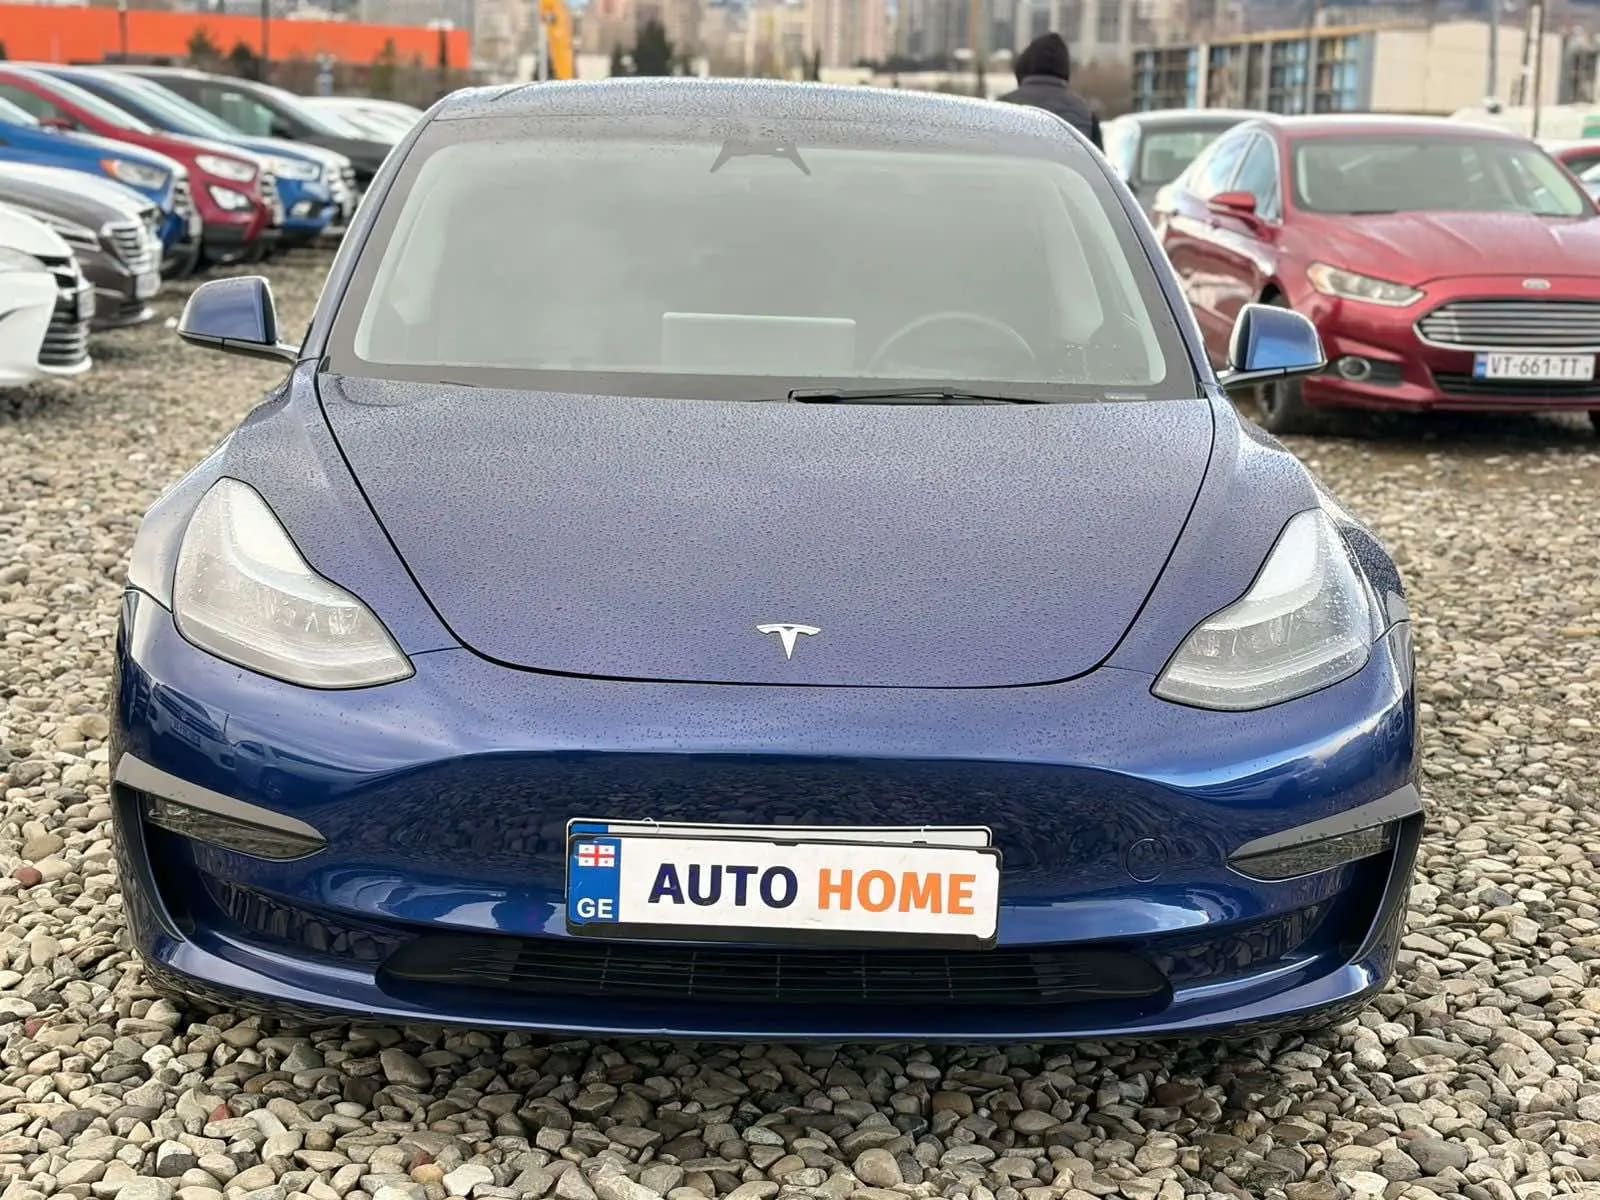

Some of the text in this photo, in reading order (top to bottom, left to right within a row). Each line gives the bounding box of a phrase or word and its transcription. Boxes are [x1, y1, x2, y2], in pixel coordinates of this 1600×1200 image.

[1491, 355, 1580, 377] VT-661-TT
[647, 863, 977, 915] AUTO HOME
[576, 897, 614, 919] GE
